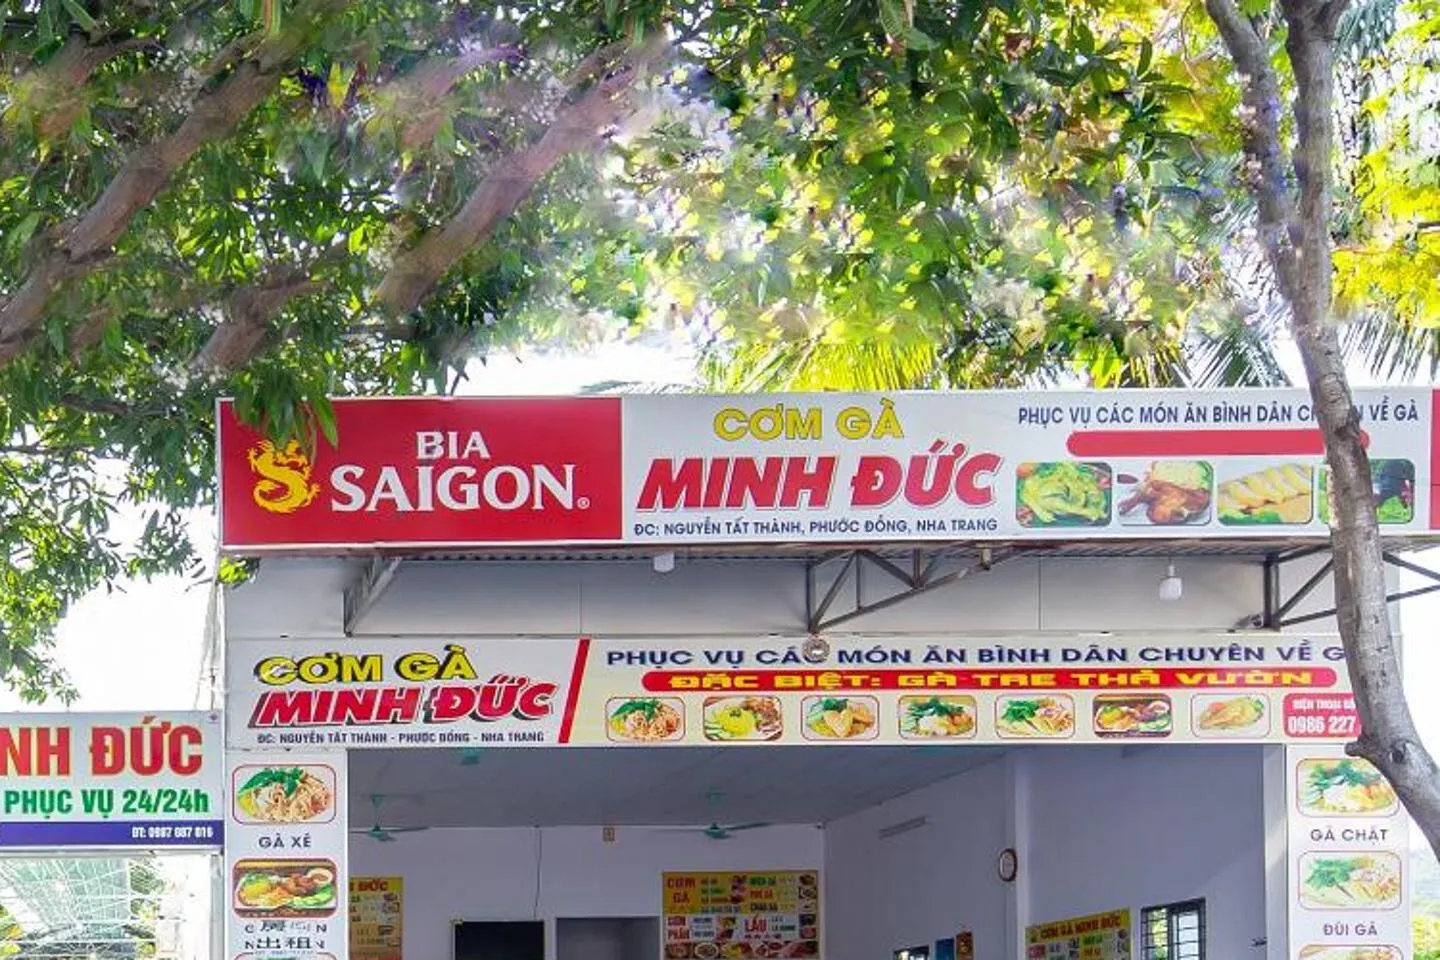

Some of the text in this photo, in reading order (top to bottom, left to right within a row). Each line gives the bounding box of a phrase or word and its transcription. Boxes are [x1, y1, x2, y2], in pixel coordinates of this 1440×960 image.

[713, 397, 905, 442] CƠM GÀ
[1018, 407, 1062, 427] PHỤC
[1069, 407, 1091, 430] VỤ
[1095, 402, 1136, 424] CÁC
[1139, 402, 1180, 424] MÓN
[1184, 403, 1208, 424] ĂN
[1213, 402, 1251, 423] BÌNH
[1257, 401, 1291, 423] DÂN
[1369, 395, 1389, 422] VỀ
[1393, 399, 1418, 421] GÀ
[416, 430, 491, 460] BIA
[636, 438, 1005, 513] MINH ĐỨC
[663, 516, 721, 536] NGUYỄN
[724, 516, 754, 535] TẤT
[754, 517, 805, 536] THÀNH,
[809, 517, 862, 534] PHƯỚC
[863, 515, 912, 535] ĐỒNG,
[916, 519, 948, 533] NHA
[950, 518, 998, 533] TRANG
[254, 644, 479, 686] CƠM GÀ
[607, 649, 695, 669] PHỤC
[703, 649, 744, 669] VỤ
[837, 645, 910, 664] MÓN
[922, 645, 965, 663] ĂN
[979, 644, 1050, 663] BÌNH
[1061, 644, 1130, 662] DÂN
[1138, 642, 1264, 663] CHUYÊN
[1275, 638, 1312, 661] VỀ
[670, 669, 1313, 690] ĐẶC BIỆT: GÀ TRE THẢ VƯỜN
[247, 675, 560, 729] MINH ĐỨC
[89, 715, 203, 777] ĐỨC
[481, 732, 504, 742] NHA
[4, 789, 73, 819] PHỤC
[81, 789, 114, 819] VỤ
[122, 788, 210, 815] 24/24h
[258, 833, 312, 849] GÀ XÉ
[1310, 826, 1336, 842] GÀ
[1355, 921, 1378, 936] GÀ
